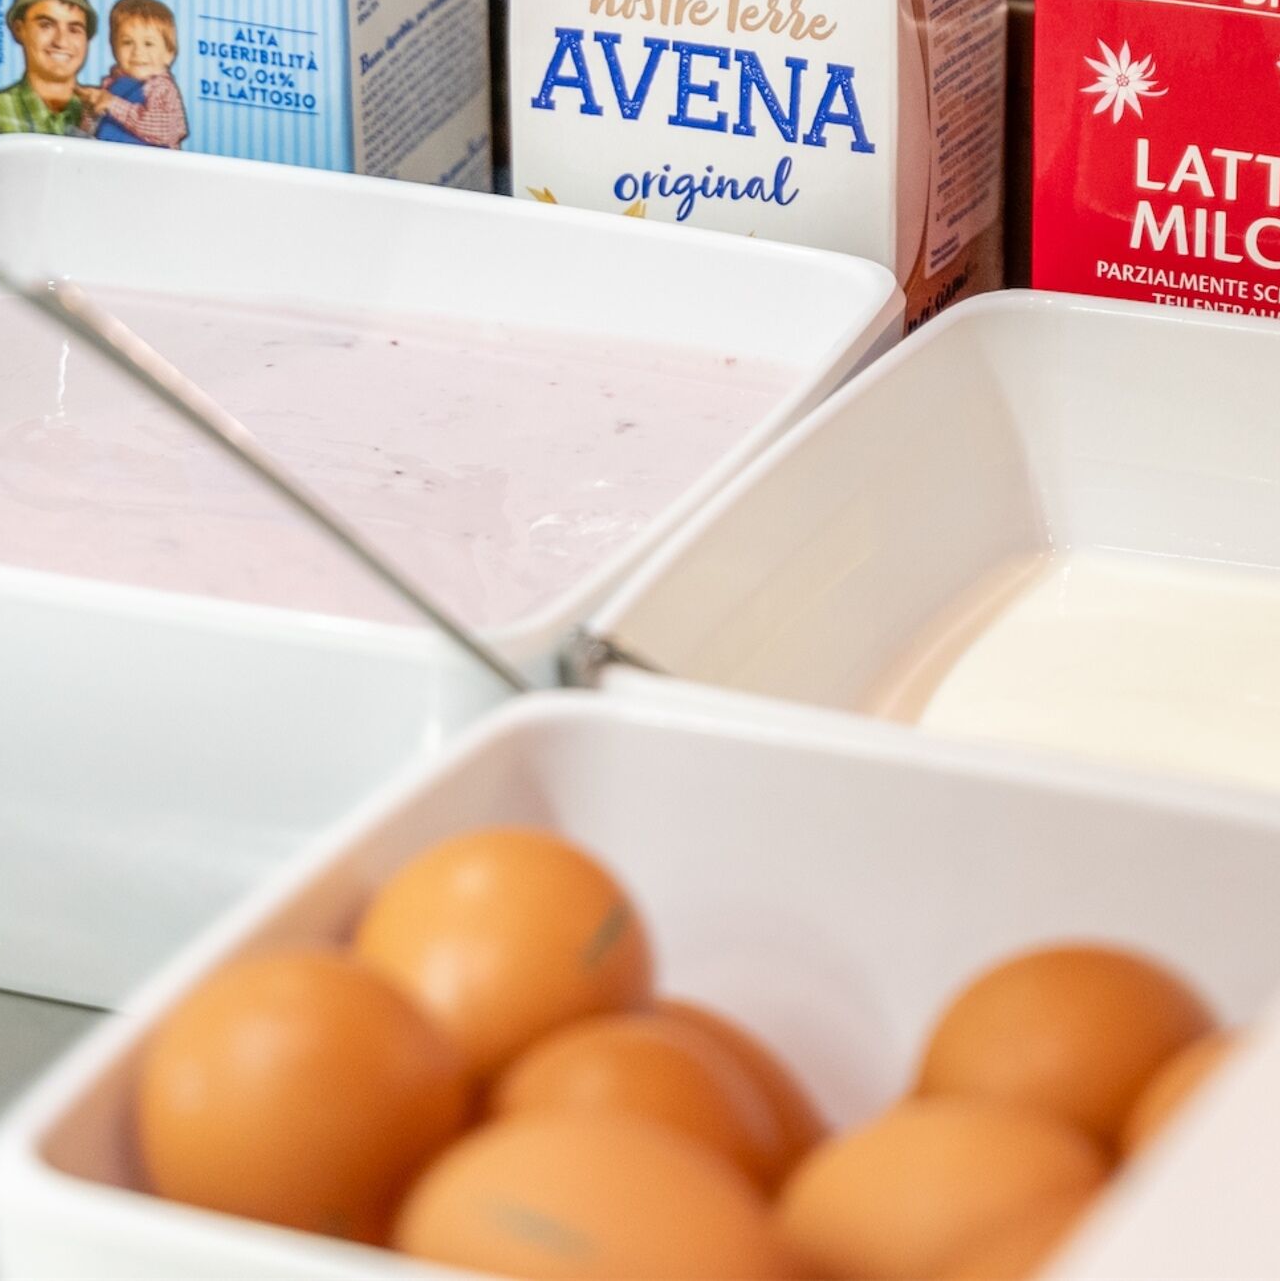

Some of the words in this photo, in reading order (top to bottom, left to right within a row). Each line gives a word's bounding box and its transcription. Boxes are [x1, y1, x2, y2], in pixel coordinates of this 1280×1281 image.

[198, 39, 319, 72] DIGERIBILITÀ
[235, 27, 279, 47] ALTA
[200, 78, 220, 97] DI
[227, 82, 317, 110] LATTOSIO
[530, 26, 877, 155] AVENA
[613, 155, 801, 222] original
[1096, 259, 1249, 300] PARZIALMENTE
